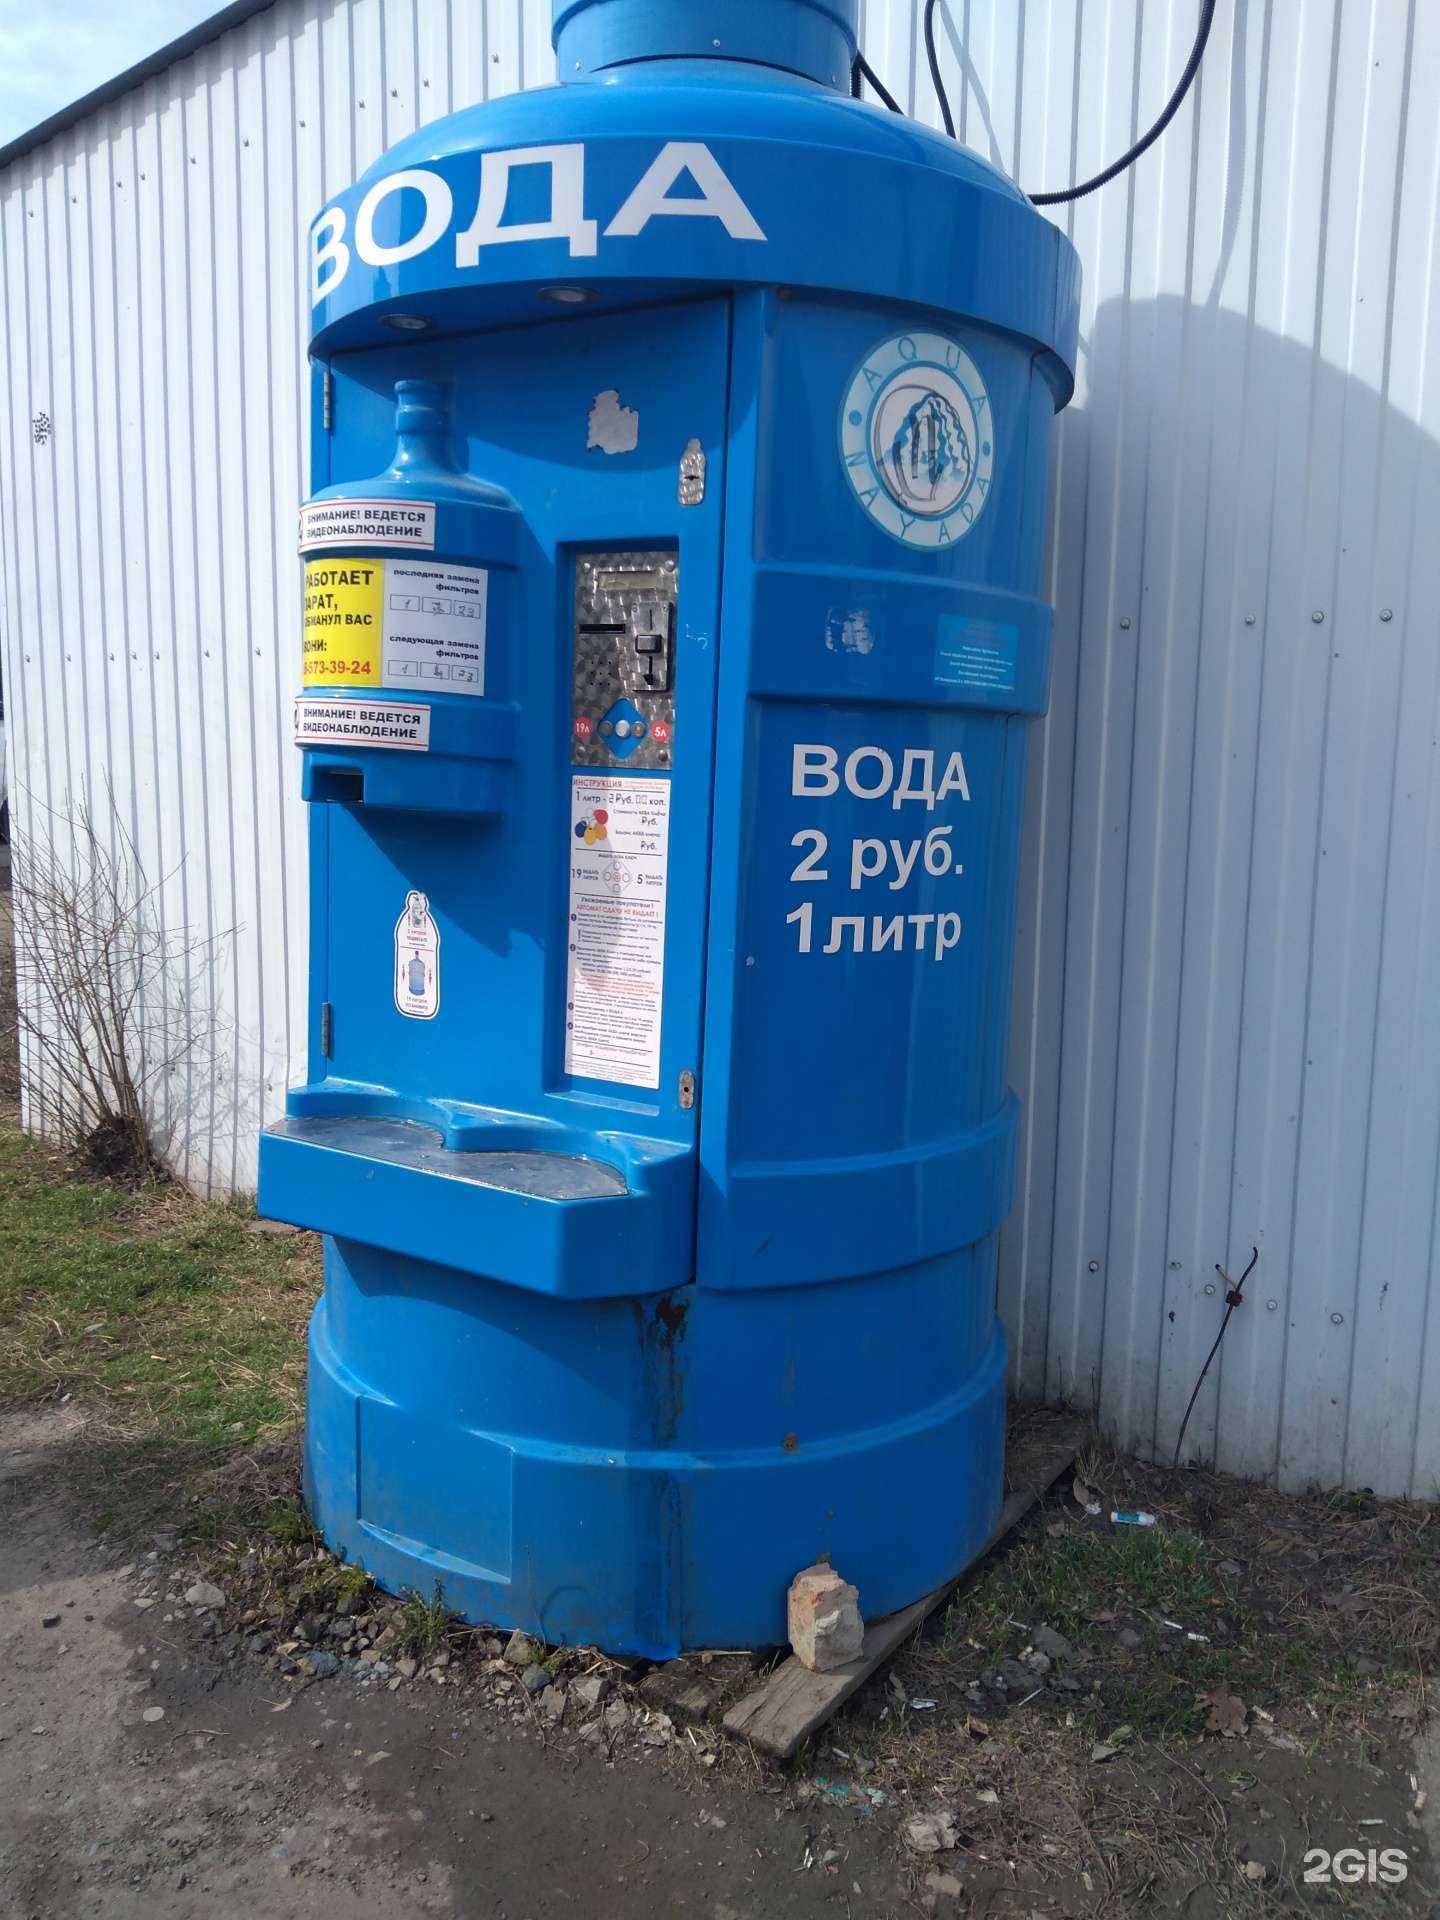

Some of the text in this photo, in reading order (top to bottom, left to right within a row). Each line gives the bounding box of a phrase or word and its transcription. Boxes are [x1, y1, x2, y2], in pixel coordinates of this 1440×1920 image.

[311, 142, 768, 303] ВОДА
[863, 336, 987, 414] AQUA
[307, 509, 426, 525] ВНИМАНИЕ! ВЕДЕТСЯ
[307, 524, 423, 539] ВИДЕОНАБЛЮДЕНИЕ
[393, 568, 480, 585] последняя замена
[435, 582, 480, 595] фильтров
[345, 614, 373, 626] ВАС
[389, 635, 479, 650] следующая замена
[435, 649, 479, 660] фильтров
[303, 708, 421, 725] ВНИМАНИЕ! ВЕДЕТСЯ
[303, 722, 418, 739] ВИДЕОНАБЛЮДЕНИЕ
[573, 778, 622, 788] ИНСТРУКЦИЯ
[791, 743, 971, 811] ВОДА
[583, 795, 601, 804] литр
[615, 792, 634, 805] Руб.
[641, 816, 658, 827] Руб.
[640, 840, 657, 851] Руб.
[790, 825, 963, 890] 2 руб.
[571, 868, 582, 879] 19
[637, 873, 644, 885] 5
[786, 902, 962, 961] 1 литр
